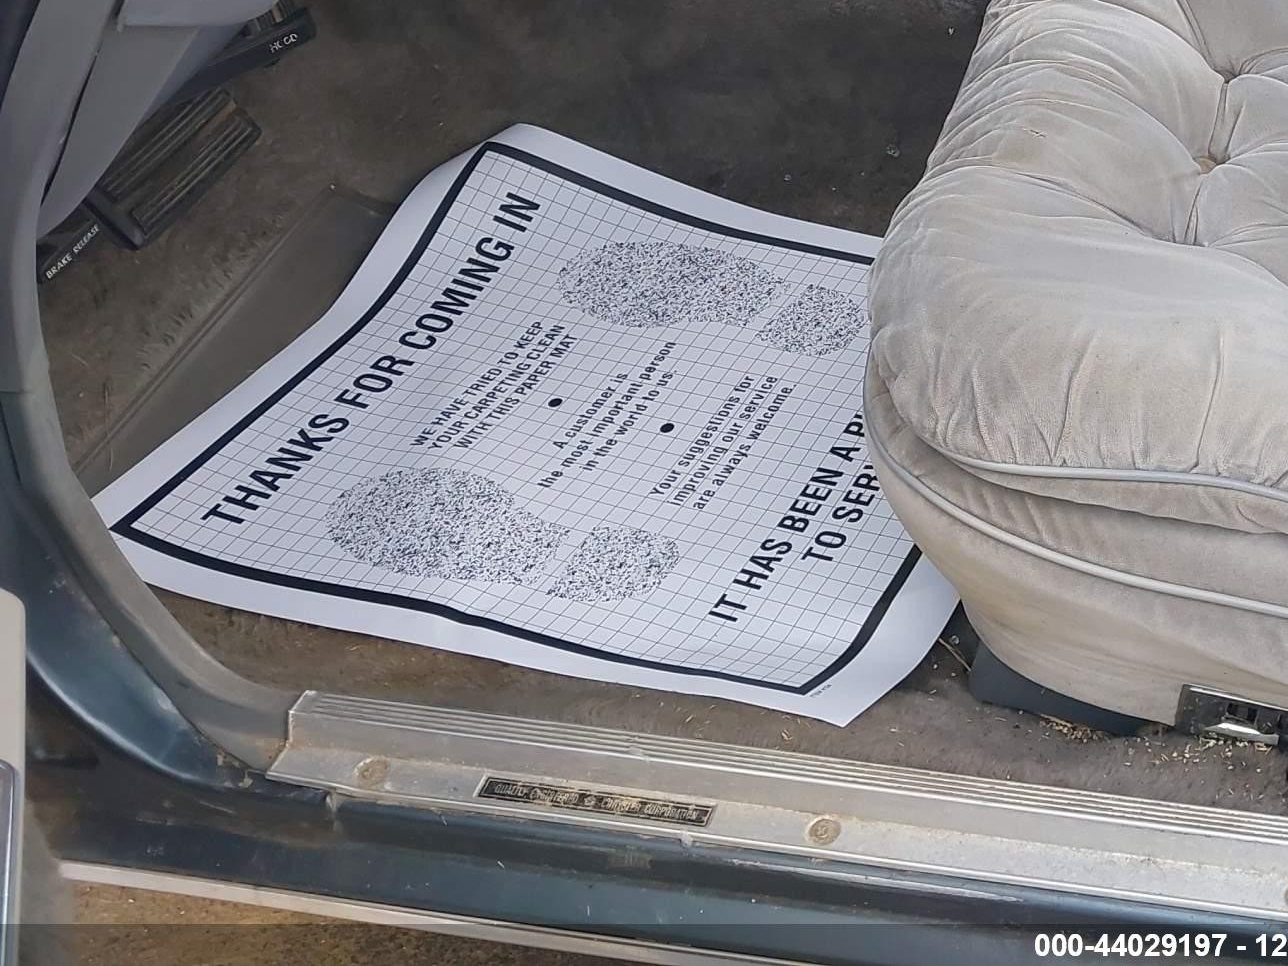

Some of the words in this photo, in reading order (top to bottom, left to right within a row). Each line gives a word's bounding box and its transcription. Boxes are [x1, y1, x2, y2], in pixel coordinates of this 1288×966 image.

[46, 253, 72, 279] BRAKE
[200, 414, 349, 524] THANKS
[334, 355, 415, 409] FOR
[399, 237, 515, 350] COMING
[493, 192, 541, 233] IN
[409, 428, 437, 446] WE
[431, 397, 469, 425] HAVE
[462, 368, 502, 396] TRIED
[497, 351, 519, 365] TO
[513, 321, 543, 349] KEEP
[427, 420, 469, 449] YOUR
[464, 362, 532, 419] CARPETING
[526, 325, 565, 360] CLEAN
[453, 421, 492, 448] WITH
[485, 397, 520, 419] THIS
[514, 360, 556, 395] PAPER
[549, 333, 578, 358] MAT
[537, 470, 564, 488] the
[560, 440, 594, 468] most
[584, 383, 643, 437] important
[638, 342, 677, 381] person
[552, 441, 569, 449] A
[565, 386, 616, 438] customer
[609, 373, 628, 384] is
[579, 460, 599, 471] in
[592, 438, 618, 456] the
[613, 404, 648, 435] world
[641, 390, 660, 401] to
[656, 370, 677, 387] us.
[649, 469, 681, 495] Your
[678, 396, 740, 467] suggestions
[734, 375, 755, 392] for
[667, 446, 729, 506] improving
[722, 422, 743, 443] our
[739, 376, 778, 420] service
[692, 489, 716, 510] are
[712, 444, 751, 486] always
[746, 384, 797, 440] welcome.
[708, 593, 747, 622] IT
[732, 538, 793, 590] HAS
[777, 467, 845, 533] BEEN
[829, 446, 861, 462] A
[801, 531, 847, 561] TO
